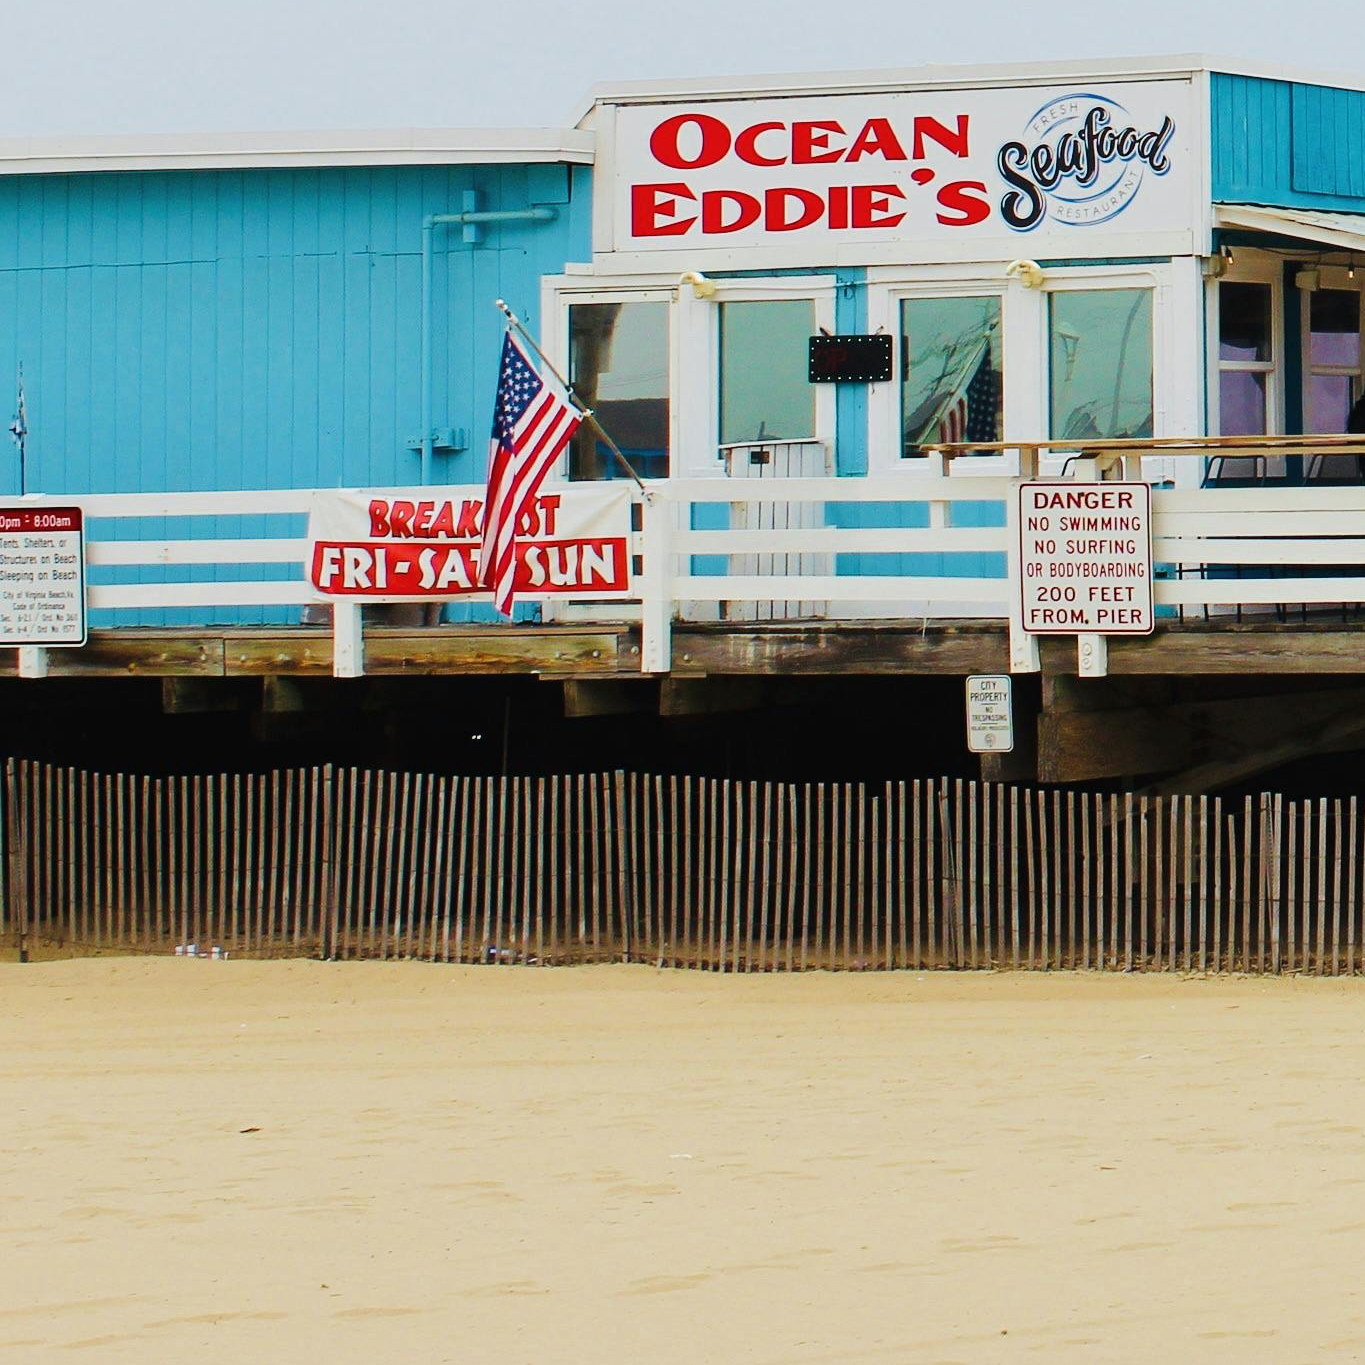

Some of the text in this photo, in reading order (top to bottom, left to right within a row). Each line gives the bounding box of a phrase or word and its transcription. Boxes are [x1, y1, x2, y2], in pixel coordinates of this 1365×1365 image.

[1032, 103, 1079, 132] FRESH
[649, 113, 970, 170] OCEAN
[998, 106, 1175, 231] Seafood
[1056, 170, 1138, 219] RESTAURANT
[631, 168, 991, 238] EDDIE'S
[1034, 492, 1133, 509] DANGER
[34, 514, 71, 527] 8:00am
[369, 494, 561, 539] BREAKST
[1028, 516, 1141, 532] NO SWIMMING
[1035, 539, 1136, 555] NO SURFING
[41, 556, 50, 564] on
[54, 553, 77, 564] Beach
[524, 544, 616, 586] SUN
[38, 571, 48, 581] on
[52, 569, 77, 581] Beach
[1027, 562, 1144, 578] OR BODYBOARDING
[1037, 587, 1135, 602] 200 FEET
[1031, 609, 1142, 624] FROM PIER
[981, 681, 997, 691] CITY
[970, 692, 1008, 702] PROPERTY
